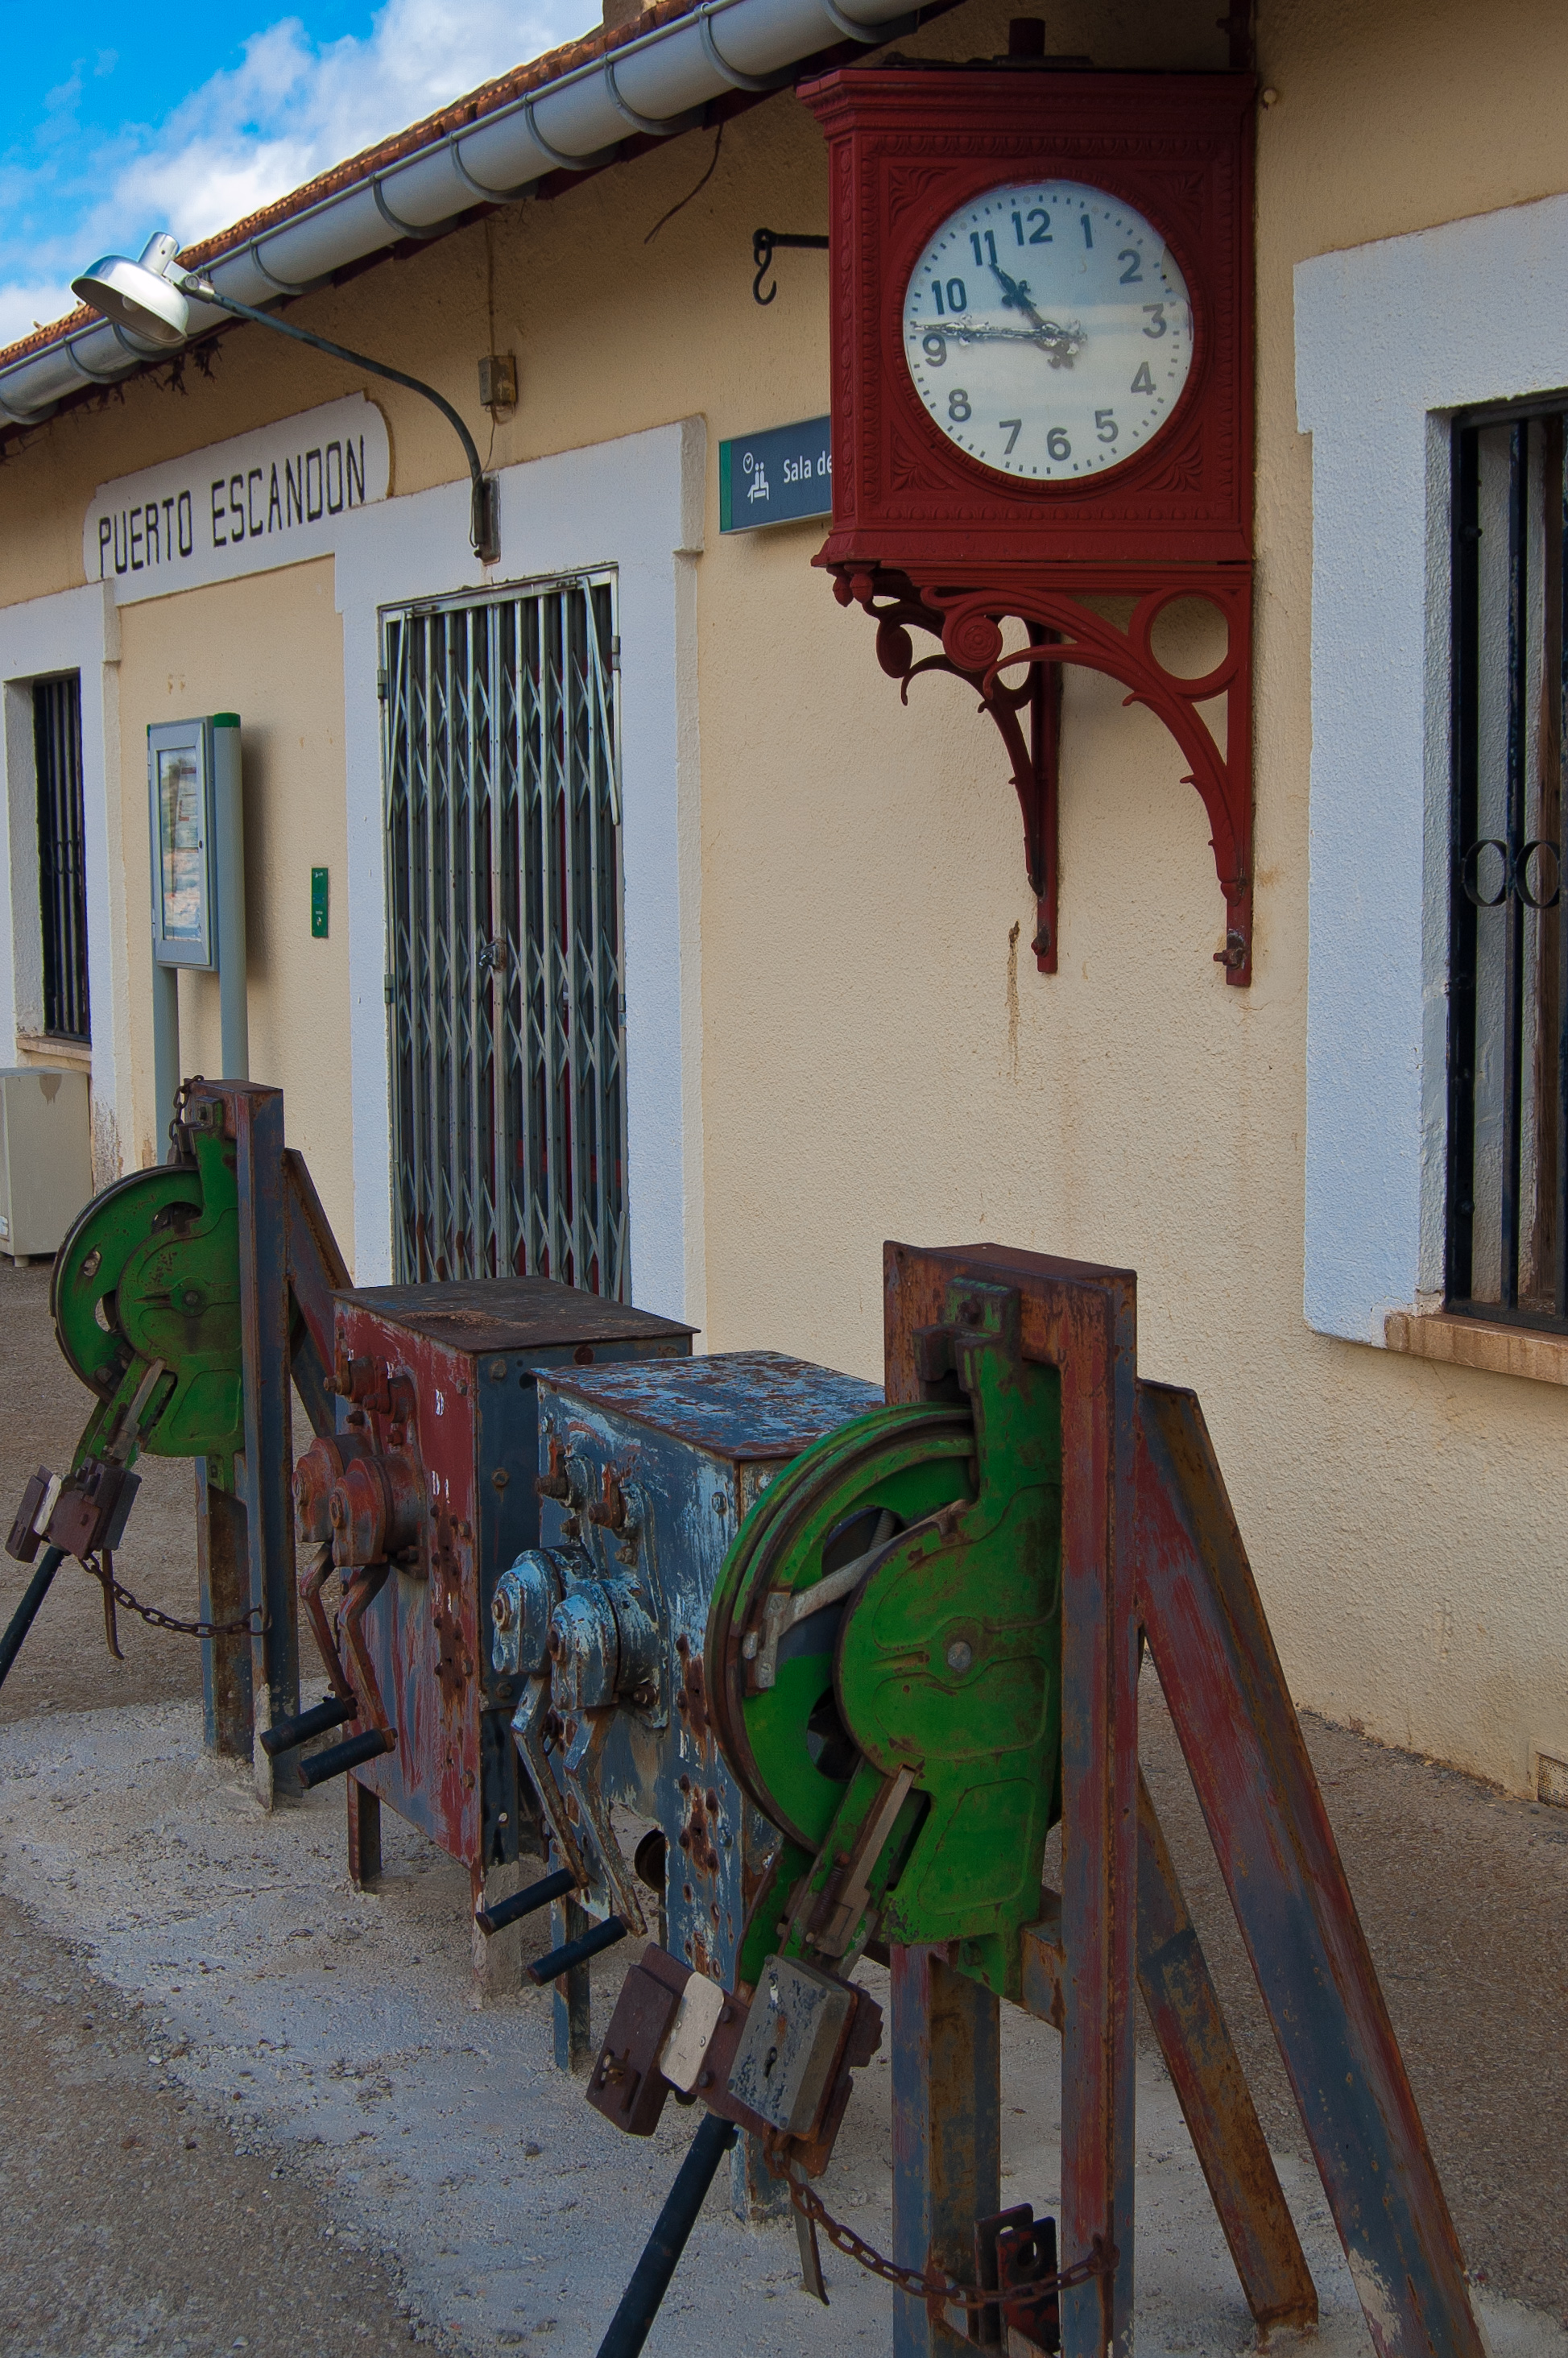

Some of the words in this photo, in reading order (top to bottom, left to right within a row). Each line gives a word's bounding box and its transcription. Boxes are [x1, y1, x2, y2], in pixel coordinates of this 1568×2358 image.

[1011, 208, 1053, 246] 12
[1080, 213, 1094, 249] 1
[969, 229, 999, 267] 11
[1117, 249, 1144, 284] 2
[931, 277, 968, 316] 10
[1142, 302, 1168, 339] 3
[922, 333, 947, 367] 9
[1130, 362, 1156, 396] 4
[948, 388, 972, 422] 8
[999, 418, 1023, 455] 7
[1094, 408, 1119, 443] 5
[1046, 427, 1072, 461] 6
[783, 454, 812, 483] Sala
[98, 489, 193, 579] PUERTO
[210, 434, 366, 548] ESCANDON
